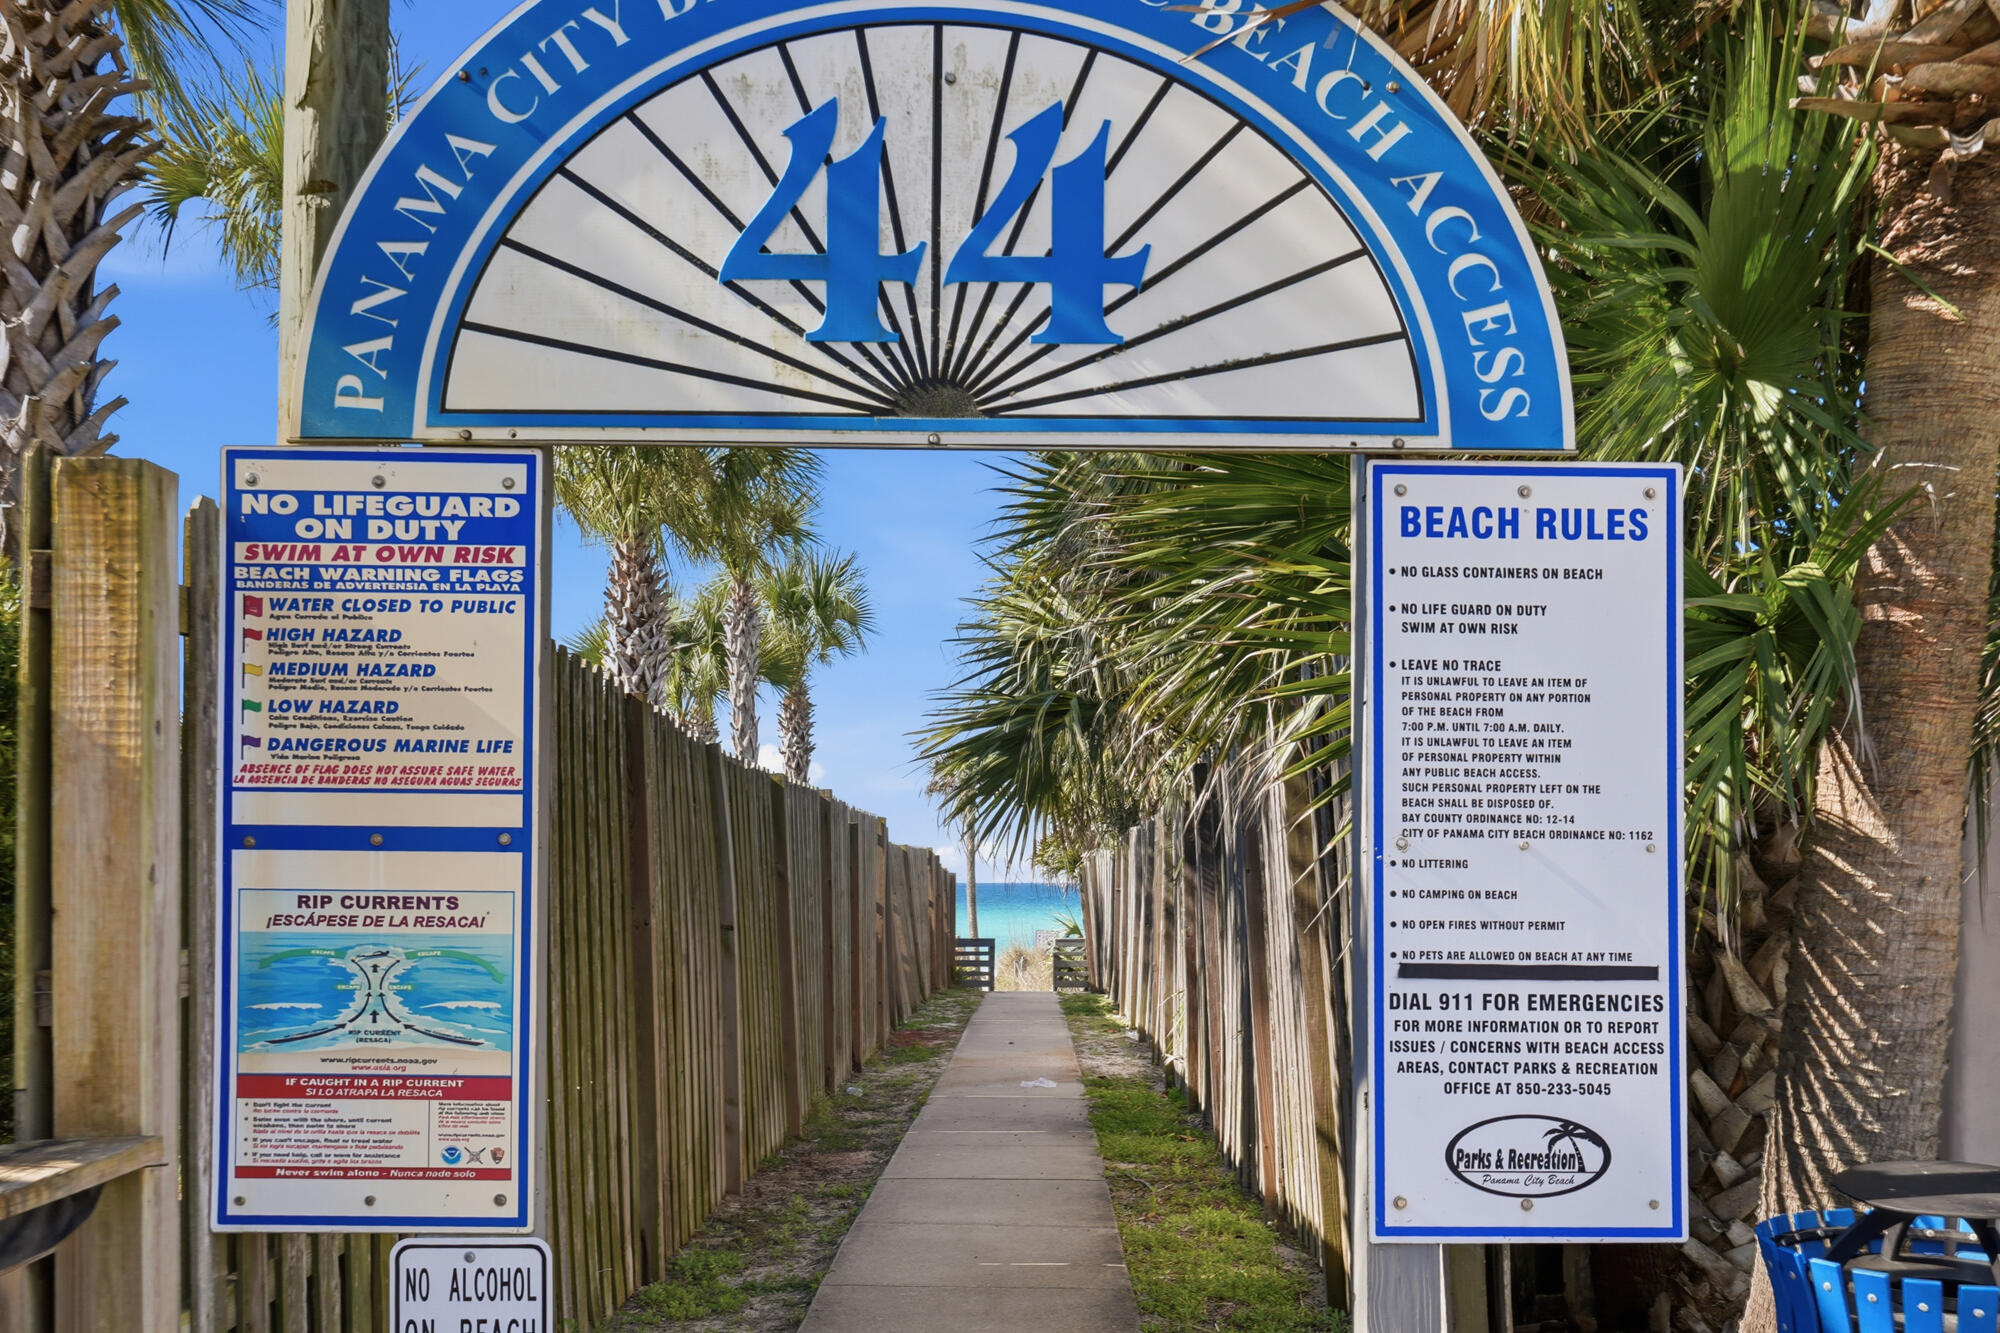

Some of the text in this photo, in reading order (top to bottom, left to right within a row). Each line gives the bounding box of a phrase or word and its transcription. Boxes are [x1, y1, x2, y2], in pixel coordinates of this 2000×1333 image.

[334, 0, 1531, 422] PANAMA CITY BEACH ACCESS
[718, 96, 1152, 345] 44
[241, 493, 520, 518] NO LIFEGUARD
[295, 517, 464, 541] ON DUTY
[1400, 505, 1648, 541] BEACH RULES
[243, 543, 516, 564] SWIM AT OWN RISK
[233, 566, 524, 583] BEACH WARNING FLAGS
[1400, 565, 1603, 580] NO GLASS CONTAINERS ON BEACH
[236, 580, 309, 589] BANDERAS
[313, 581, 331, 589] DE
[431, 582, 451, 591] EN
[454, 582, 472, 591] LA
[475, 582, 520, 592] PLAYA
[268, 597, 516, 614] WATER CLOSED TO PUBLIC
[1401, 602, 1547, 616] NO LIFE GUARD ON DUTY
[1401, 621, 1518, 634] SWIM AT OWN RISK
[266, 627, 402, 644] HIGH HAZARD
[268, 661, 436, 677] MEDIUM HAZARD
[1401, 658, 1500, 672] LEAVE NO TRACE
[267, 698, 399, 714] LOW HAZARD
[266, 737, 514, 753] DANGEROUS MARINE LIFE
[239, 763, 515, 776] ABSENCE OF FLAG DOES NOT ASSURE SAFE WATER
[231, 774, 245, 784] LA
[300, 775, 315, 785] DE
[317, 775, 372, 785] BANDERAS
[373, 776, 388, 785] NO
[390, 776, 437, 786] ASEGURA
[439, 776, 473, 786] AGUAS
[474, 776, 526, 786] SEGURAS
[1401, 828, 1653, 841] CITY OF PANAMA CITY BEACH ORDINANCE NO: 1162
[297, 894, 459, 910] RIP CURRENTS
[361, 915, 386, 927] DE
[388, 915, 409, 928] LA
[1401, 950, 1632, 962] NO PETS ARE ALLOWED ON BEACH AT ANY TIME
[1389, 992, 1663, 1012] DIAL 911 FOR EMERGENCIES
[1394, 1019, 1659, 1034] FOR MORE INFORMATION OR TO REPORT
[1389, 1039, 1664, 1055] ISSUES / CONCERNS WITH BEACH ACCESS
[1396, 1060, 1658, 1075] AREAS, CONTACT PARKS & RECREATION
[285, 1077, 464, 1087] IF CAUGHT IN A RIP CURRENT
[1443, 1081, 1611, 1095] OFFICE AT 850-233-5045
[305, 1087, 443, 1097] SI LO ATRAPA LA RESACA
[1456, 1148, 1576, 1171] Parks & Recreation
[275, 1168, 311, 1176] Never
[389, 1169, 424, 1177] Nunca
[1482, 1174, 1575, 1187] Panama City Beach
[405, 1267, 537, 1302] NO ALCOHOL
